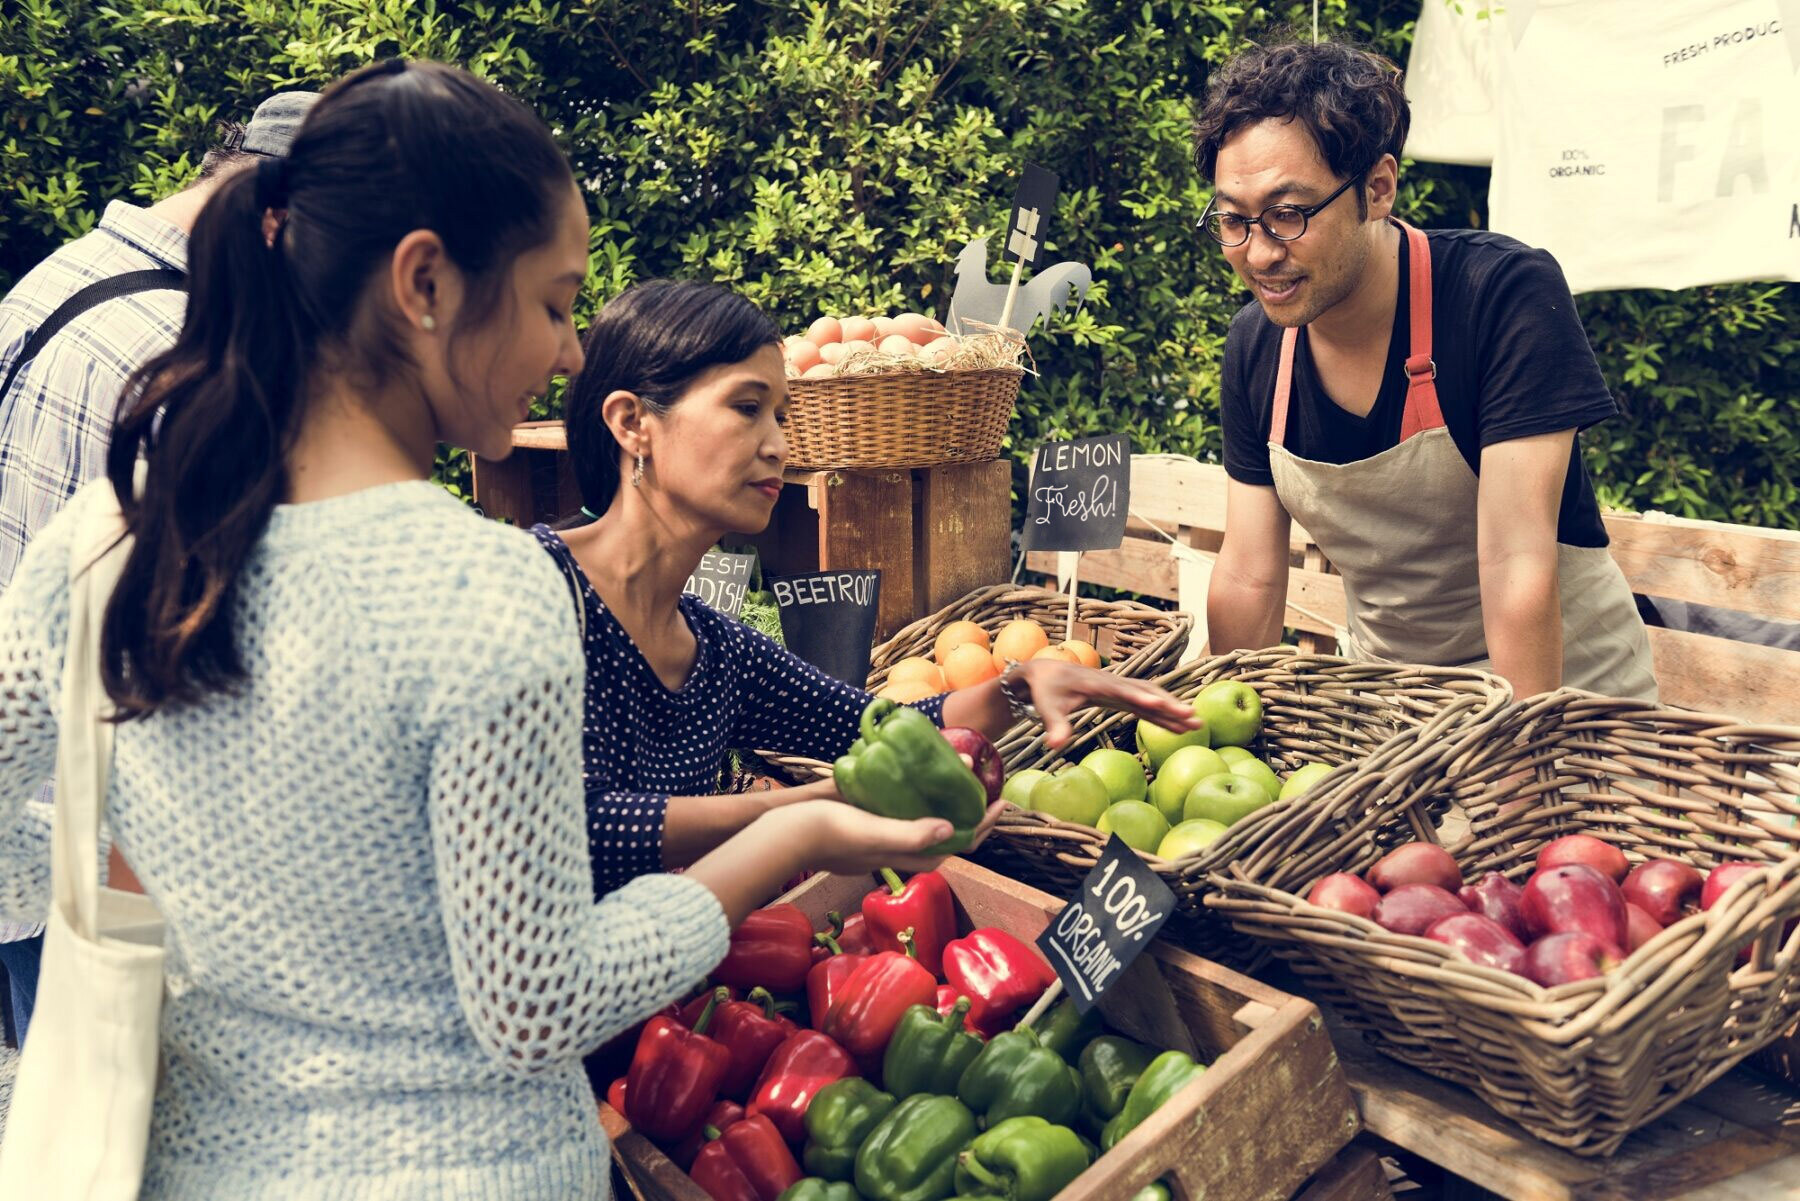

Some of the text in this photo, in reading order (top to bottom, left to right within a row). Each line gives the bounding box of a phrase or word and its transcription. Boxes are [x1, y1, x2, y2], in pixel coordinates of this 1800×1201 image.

[1663, 41, 1709, 69] FRESH
[1549, 163, 1606, 178] ORGANIC
[1042, 441, 1121, 472] LEMON
[1035, 474, 1118, 524] Fresh!
[773, 574, 877, 607] BEETROOT
[1091, 858, 1163, 941] 100%
[1057, 902, 1122, 992] ORGANIC
